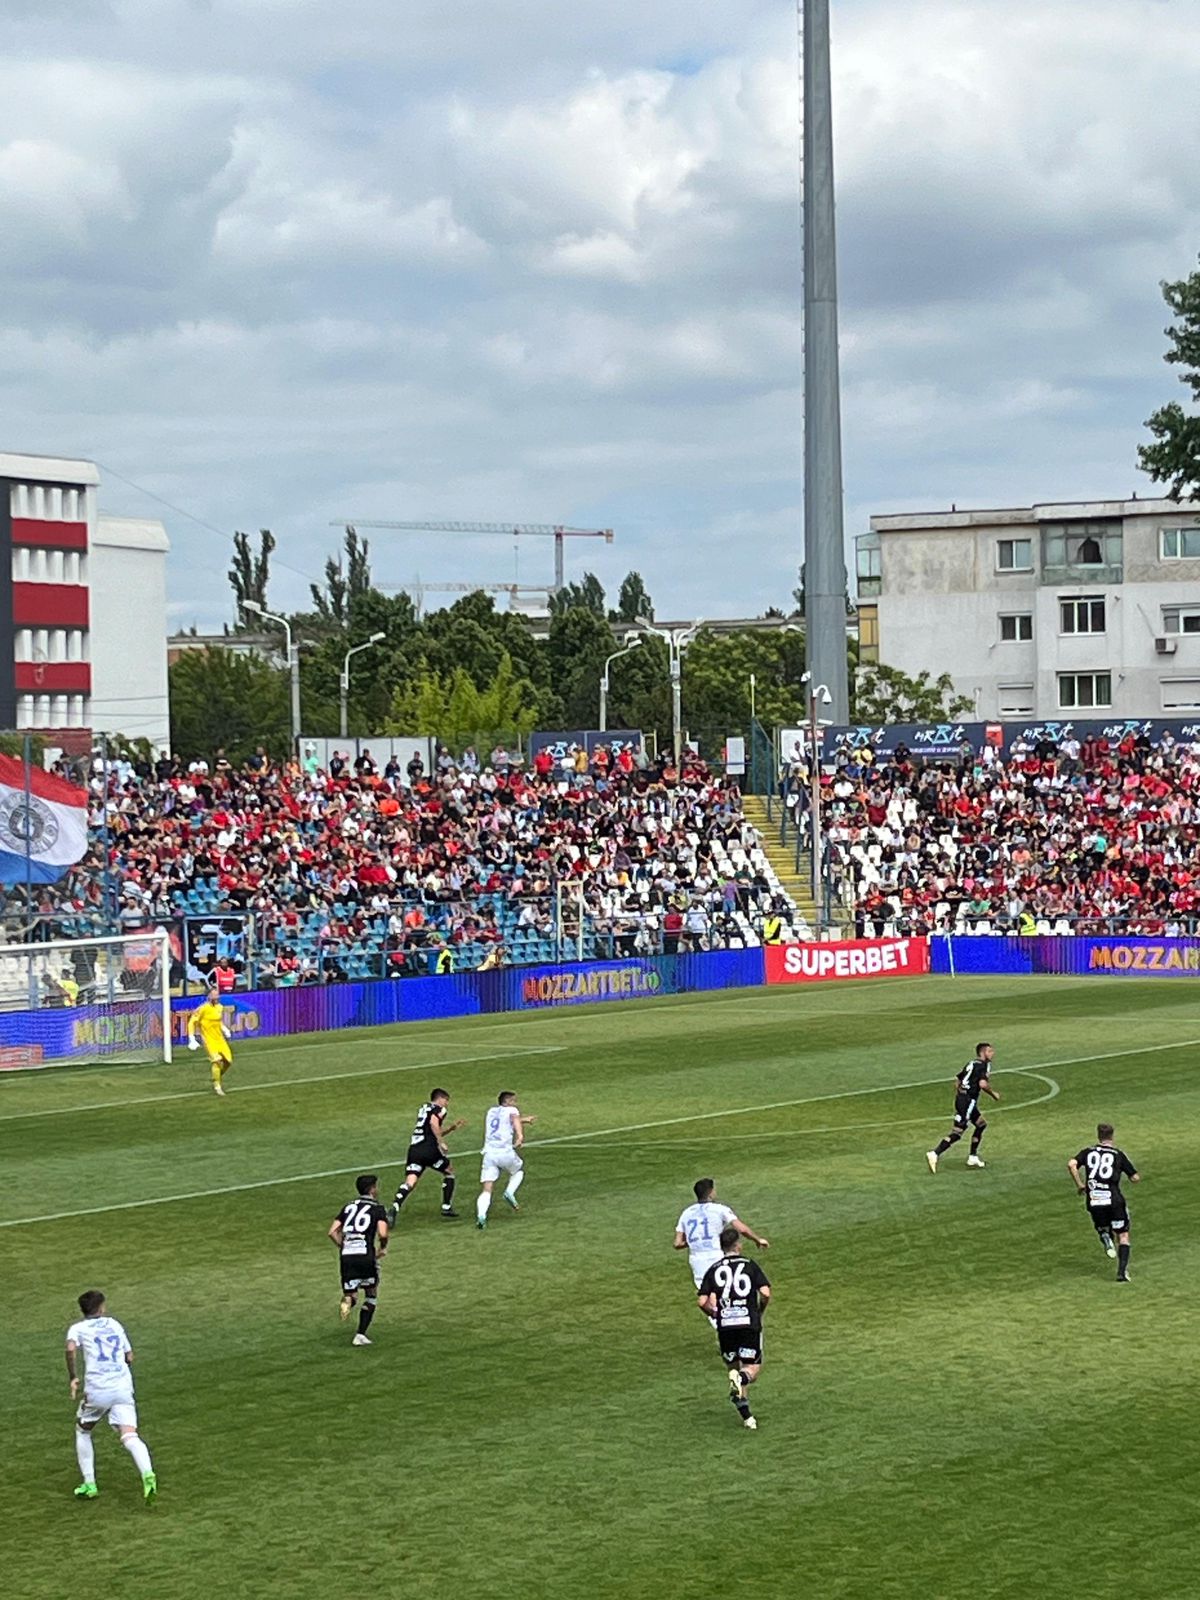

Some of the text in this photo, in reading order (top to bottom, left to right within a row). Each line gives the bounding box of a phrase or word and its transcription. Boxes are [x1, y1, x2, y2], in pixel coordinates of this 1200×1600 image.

[784, 940, 909, 976] SUPERBET
[489, 1117, 501, 1136] 9
[1087, 1150, 1114, 1179] 98
[342, 1203, 371, 1232] 26
[687, 1217, 713, 1243] 21
[714, 1262, 752, 1301] 96
[93, 1335, 120, 1363] 17
